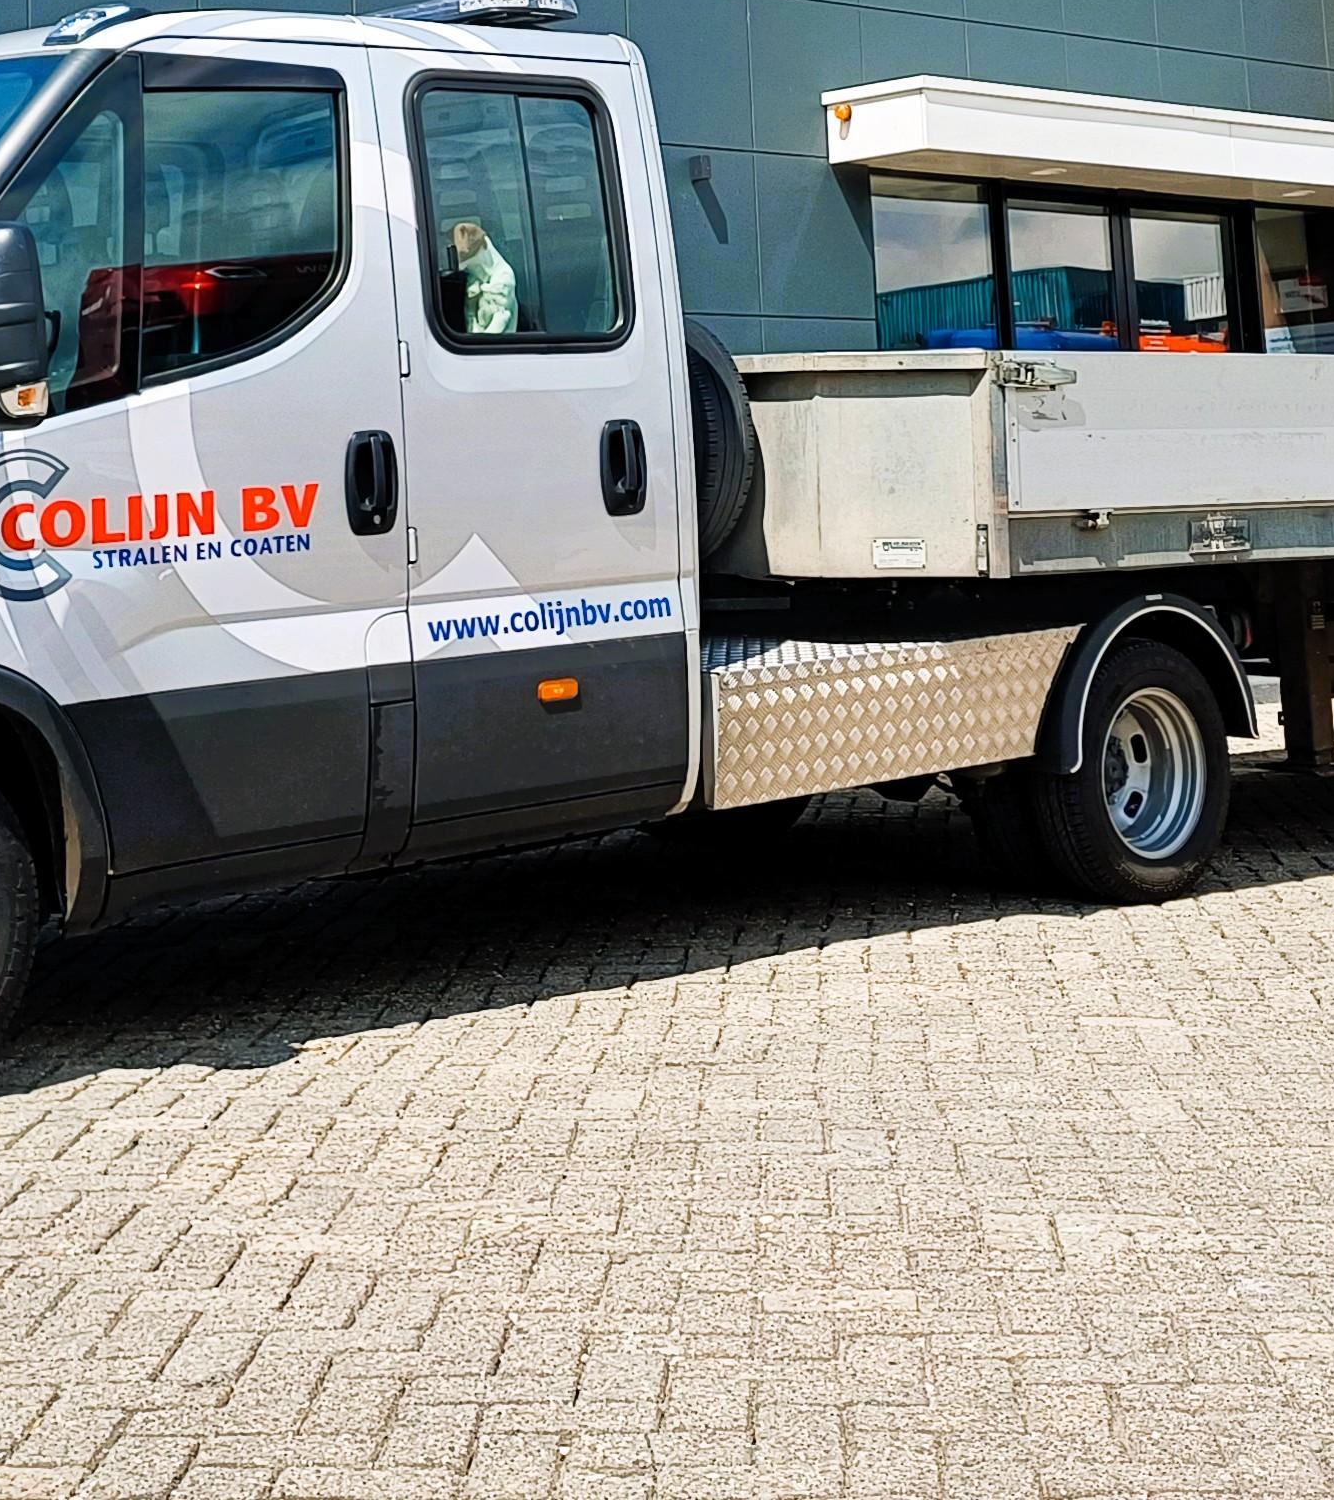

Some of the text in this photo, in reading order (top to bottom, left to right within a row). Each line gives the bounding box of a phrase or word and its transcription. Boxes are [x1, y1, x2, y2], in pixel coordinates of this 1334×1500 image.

[0, 483, 319, 552] COLIJN BV
[93, 533, 311, 569] STRALEN EN COATEN
[427, 596, 672, 642] www.colijnbv.com
